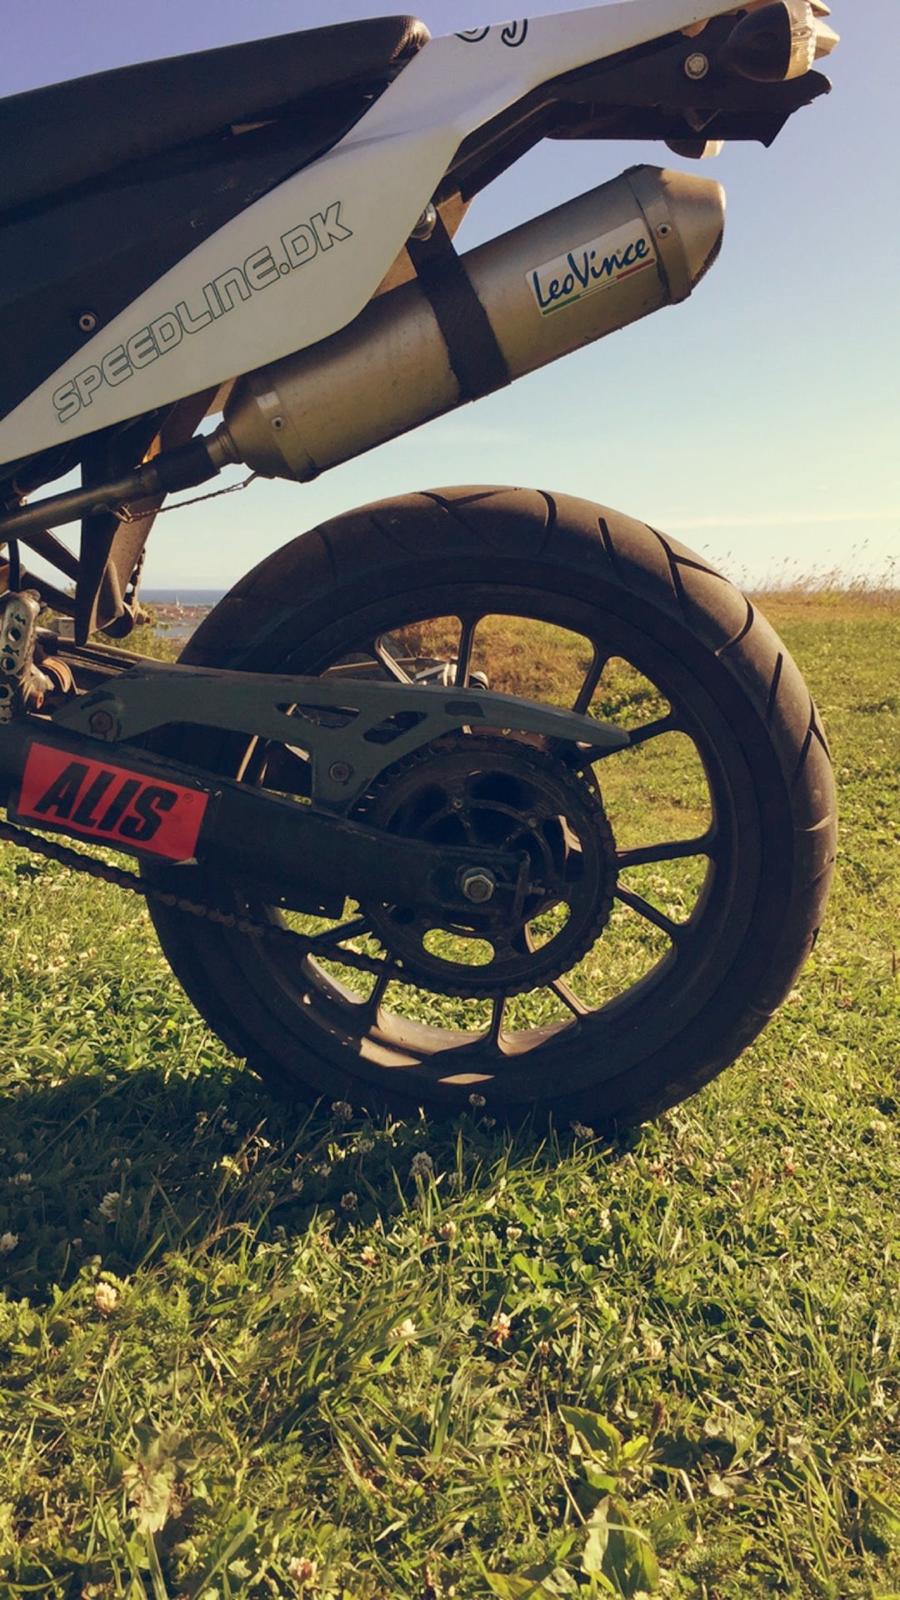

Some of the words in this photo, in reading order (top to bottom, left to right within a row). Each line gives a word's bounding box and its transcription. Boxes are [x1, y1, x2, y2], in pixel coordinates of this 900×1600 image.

[52, 201, 353, 423] SPEEDLINE.DK
[533, 238, 650, 308] LeoVince
[34, 761, 178, 842] ALIS
